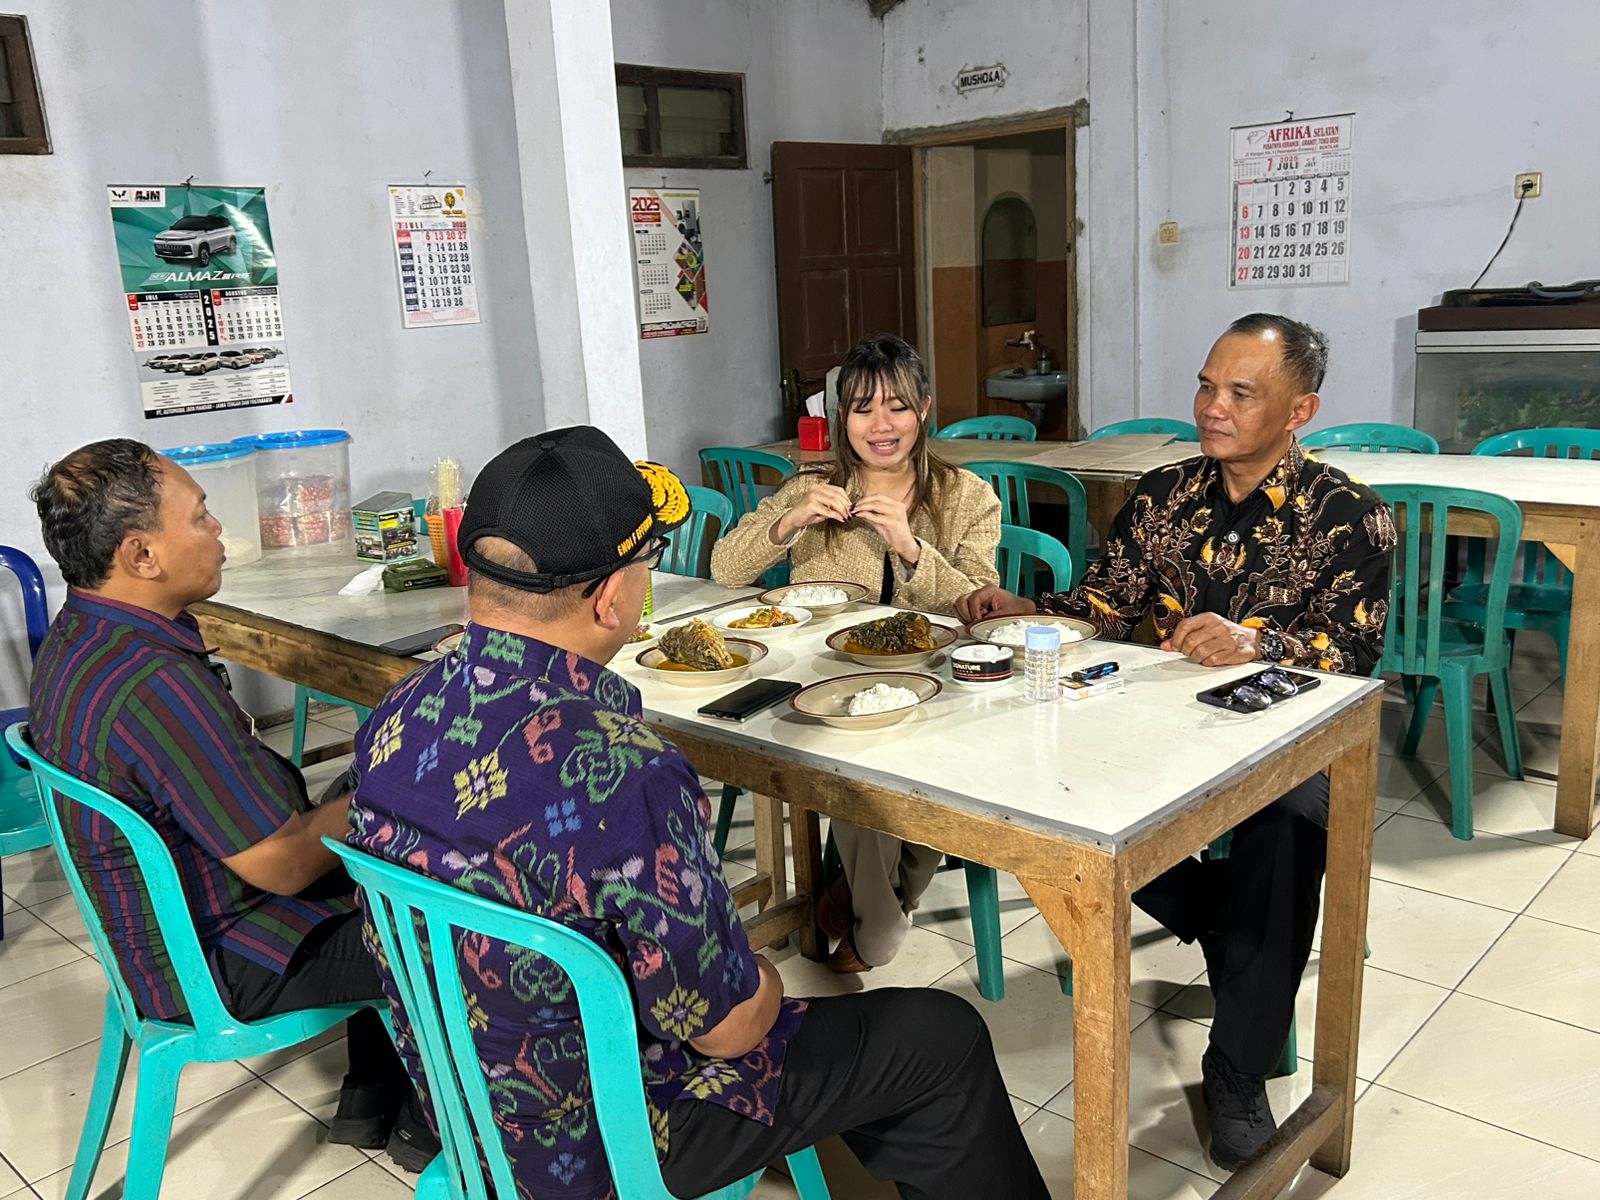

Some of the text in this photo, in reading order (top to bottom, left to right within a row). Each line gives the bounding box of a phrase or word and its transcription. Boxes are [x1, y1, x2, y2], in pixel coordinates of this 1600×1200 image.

[961, 71, 999, 88] MUSHOLA
[1267, 126, 1339, 142] AFRIKA SELATAN
[1267, 158, 1272, 171] 7
[1277, 162, 1298, 170] JULI
[1274, 178, 1344, 196] 1 2 3 4 5
[136, 191, 160, 200] AJM
[632, 197, 659, 211] 2025
[1242, 200, 1346, 219] 6 7 8 9 10 11 12
[426, 232, 430, 240] 6
[435, 232, 443, 240] 13
[447, 232, 456, 240] 20
[1240, 221, 1344, 239] 13 14 15 16 17 18 19
[436, 243, 445, 251] 14
[459, 242, 468, 250] 28
[1238, 242, 1344, 259] 20 21 22 23 24 25 26
[417, 253, 469, 263] 1 8 15 22 29
[418, 264, 470, 274] 2 9 16 23 30
[1238, 264, 1310, 280] 27 28 29 30 31
[164, 271, 223, 282] ALMAZ
[419, 275, 471, 286] 3 10 17 24 31
[442, 287, 450, 296] 18
[453, 287, 462, 295] 25
[422, 298, 463, 308] 5 12 19 26
